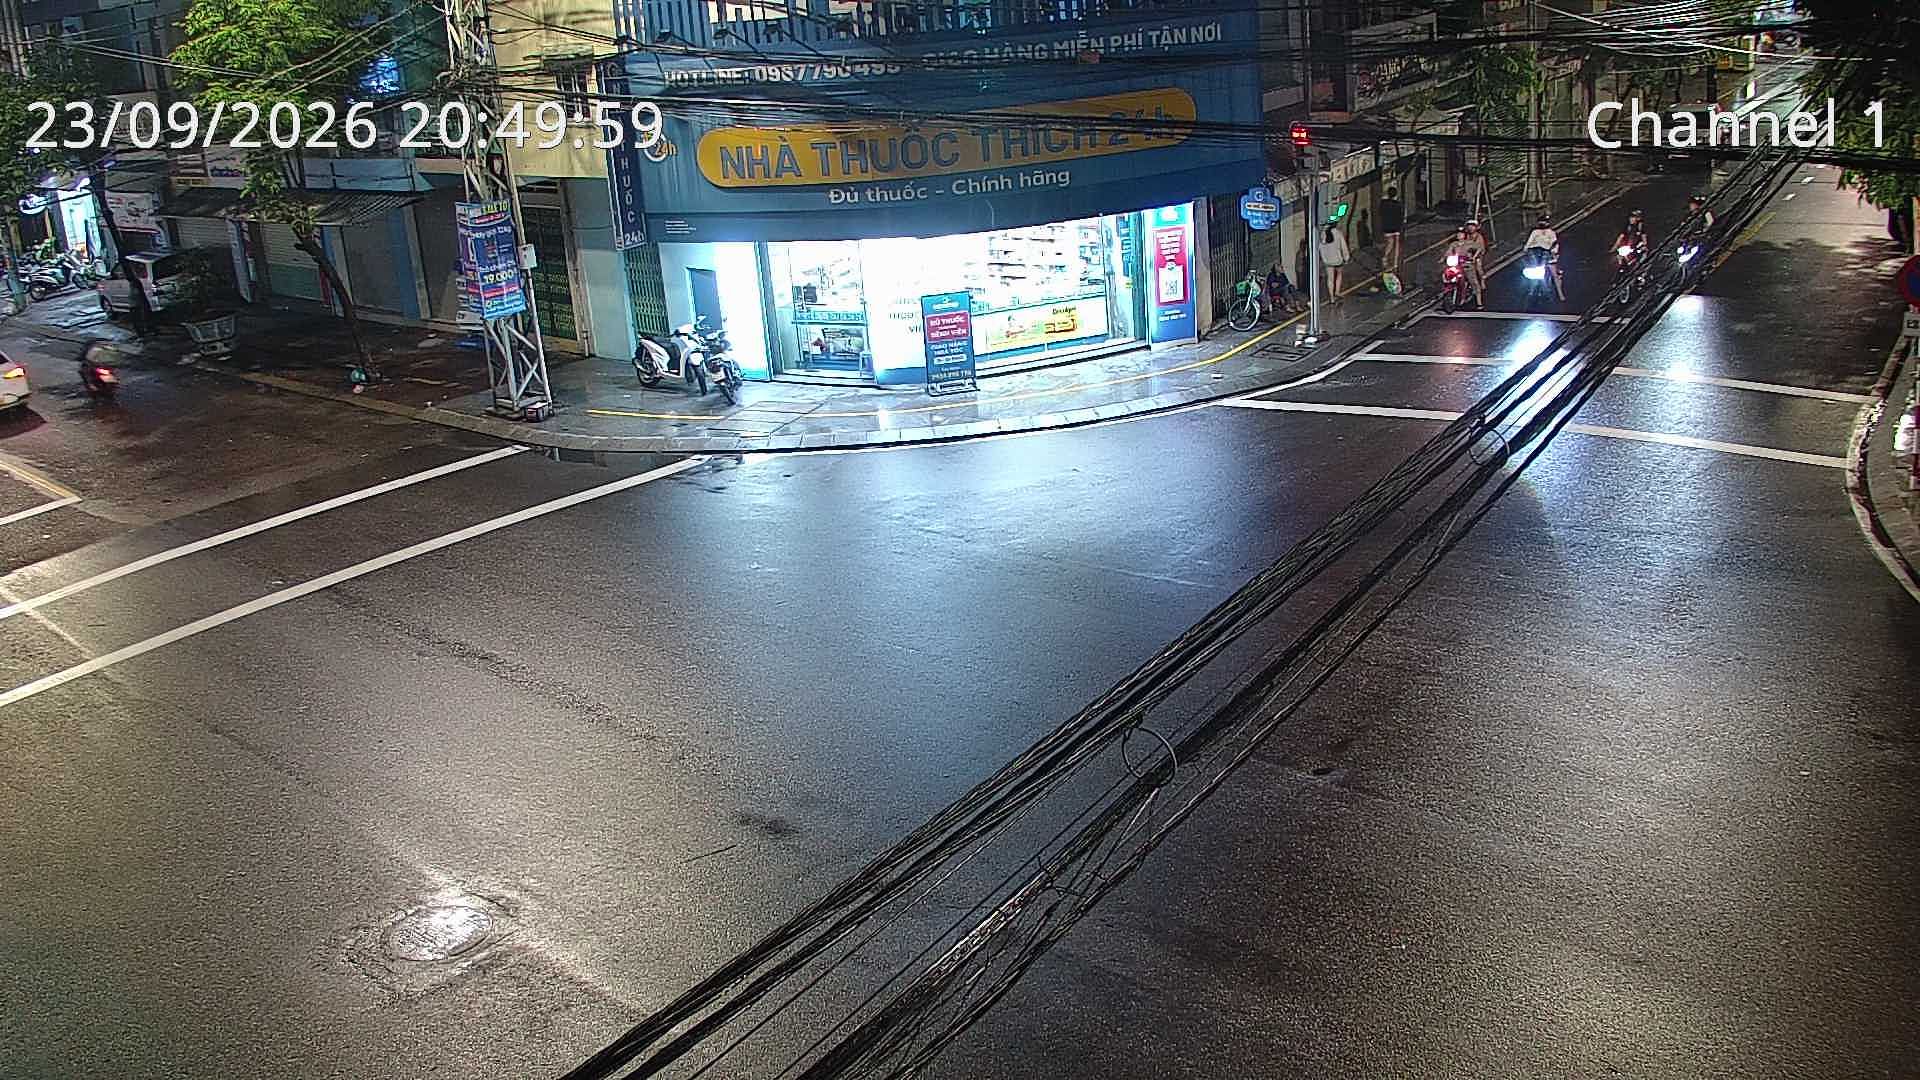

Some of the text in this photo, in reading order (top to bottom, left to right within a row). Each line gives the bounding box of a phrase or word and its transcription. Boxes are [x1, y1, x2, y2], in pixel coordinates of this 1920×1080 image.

[1110, 27, 1143, 52] PHÍ
[1149, 24, 1189, 51] TẬN
[1190, 22, 1222, 43] NƠI
[718, 135, 802, 180] NHÀ
[811, 122, 960, 176] THUỐC
[828, 186, 859, 205] Đủ
[864, 182, 928, 203] thuốc
[952, 175, 1012, 196] Chính
[1019, 169, 1071, 190] hãng
[624, 230, 645, 246] 24h
